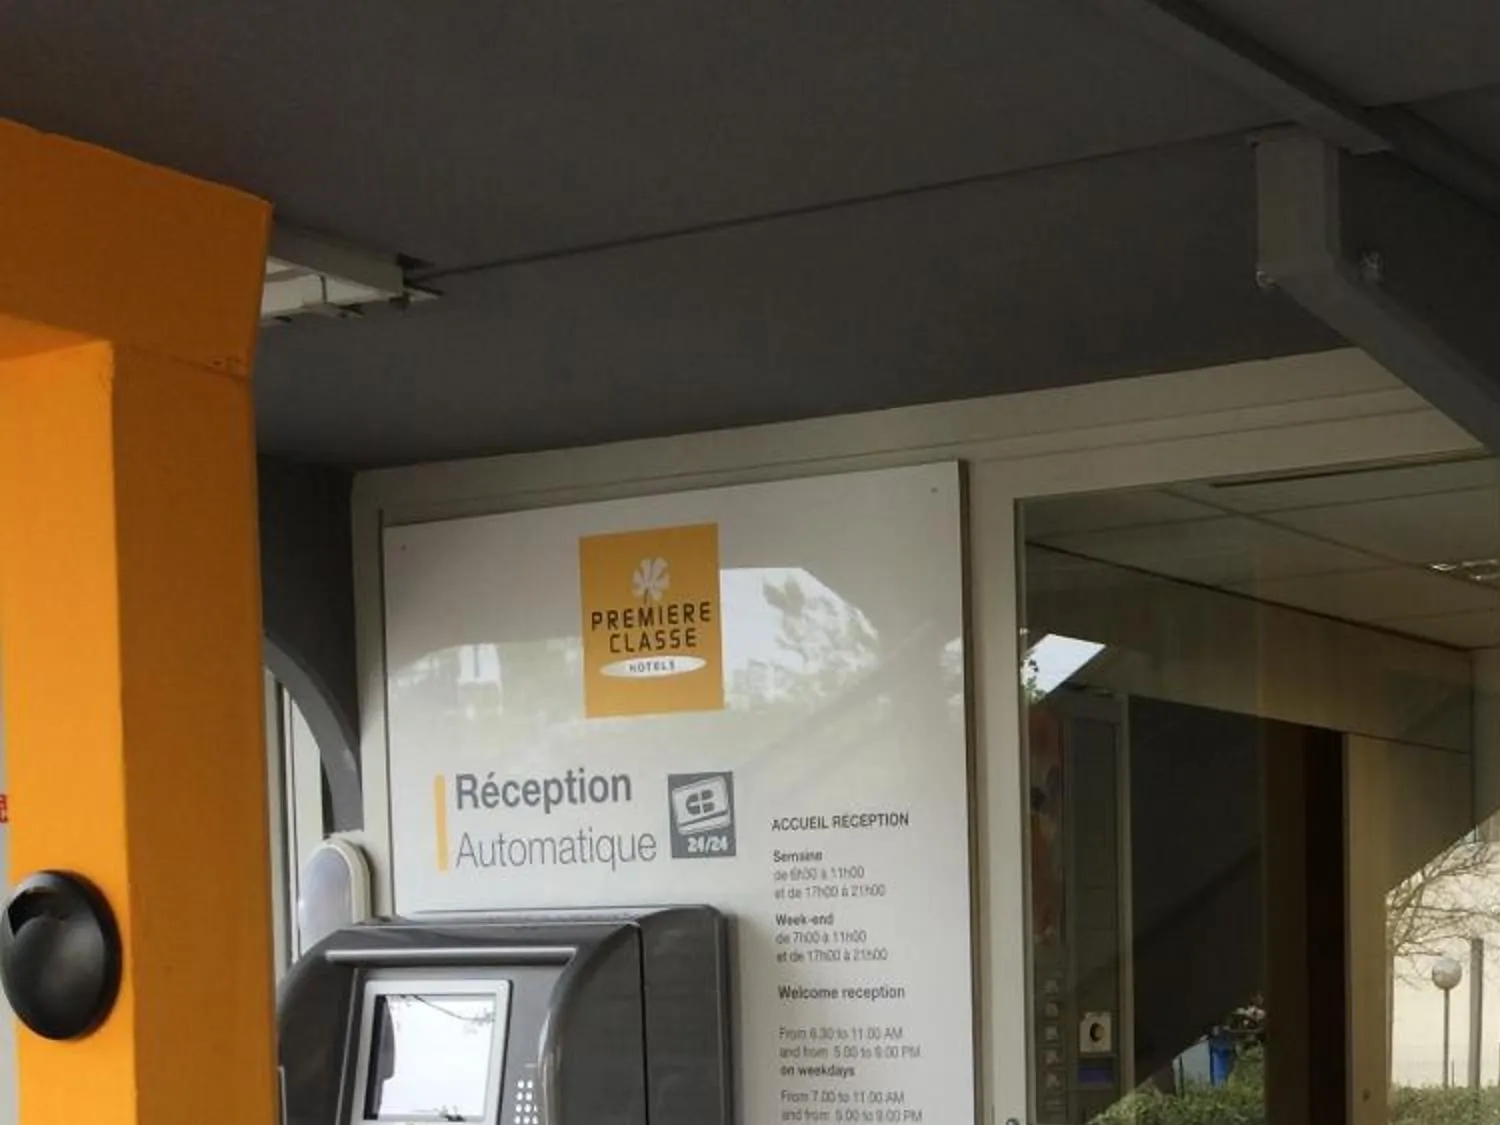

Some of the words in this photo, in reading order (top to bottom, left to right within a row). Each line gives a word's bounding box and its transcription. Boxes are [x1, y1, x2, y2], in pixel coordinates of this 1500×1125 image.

[591, 602, 711, 631] PREMIERE
[609, 628, 697, 653] CLASSE
[629, 661, 675, 673] HOTELS
[456, 768, 632, 814] Réception
[771, 816, 829, 831] ACCUEIL
[456, 827, 657, 871] Automatique
[687, 835, 728, 853] 24/24
[831, 866, 865, 879] 11h00
[787, 887, 802, 899] de
[805, 885, 839, 899] 17h00
[851, 884, 886, 897] 21h00
[775, 912, 834, 926] Week-end
[833, 929, 867, 943] 11h00
[778, 985, 839, 999] Welcome
[841, 985, 905, 1001] reception
[779, 1026, 807, 1040] From
[884, 1027, 903, 1040] AM
[779, 1046, 801, 1058] and
[803, 1045, 829, 1058] from
[901, 1045, 922, 1058] PM
[780, 1066, 795, 1076] on
[797, 1064, 856, 1079] weekdays
[781, 1089, 809, 1103] From
[885, 1090, 905, 1104] AM
[903, 1109, 922, 1123] PM
